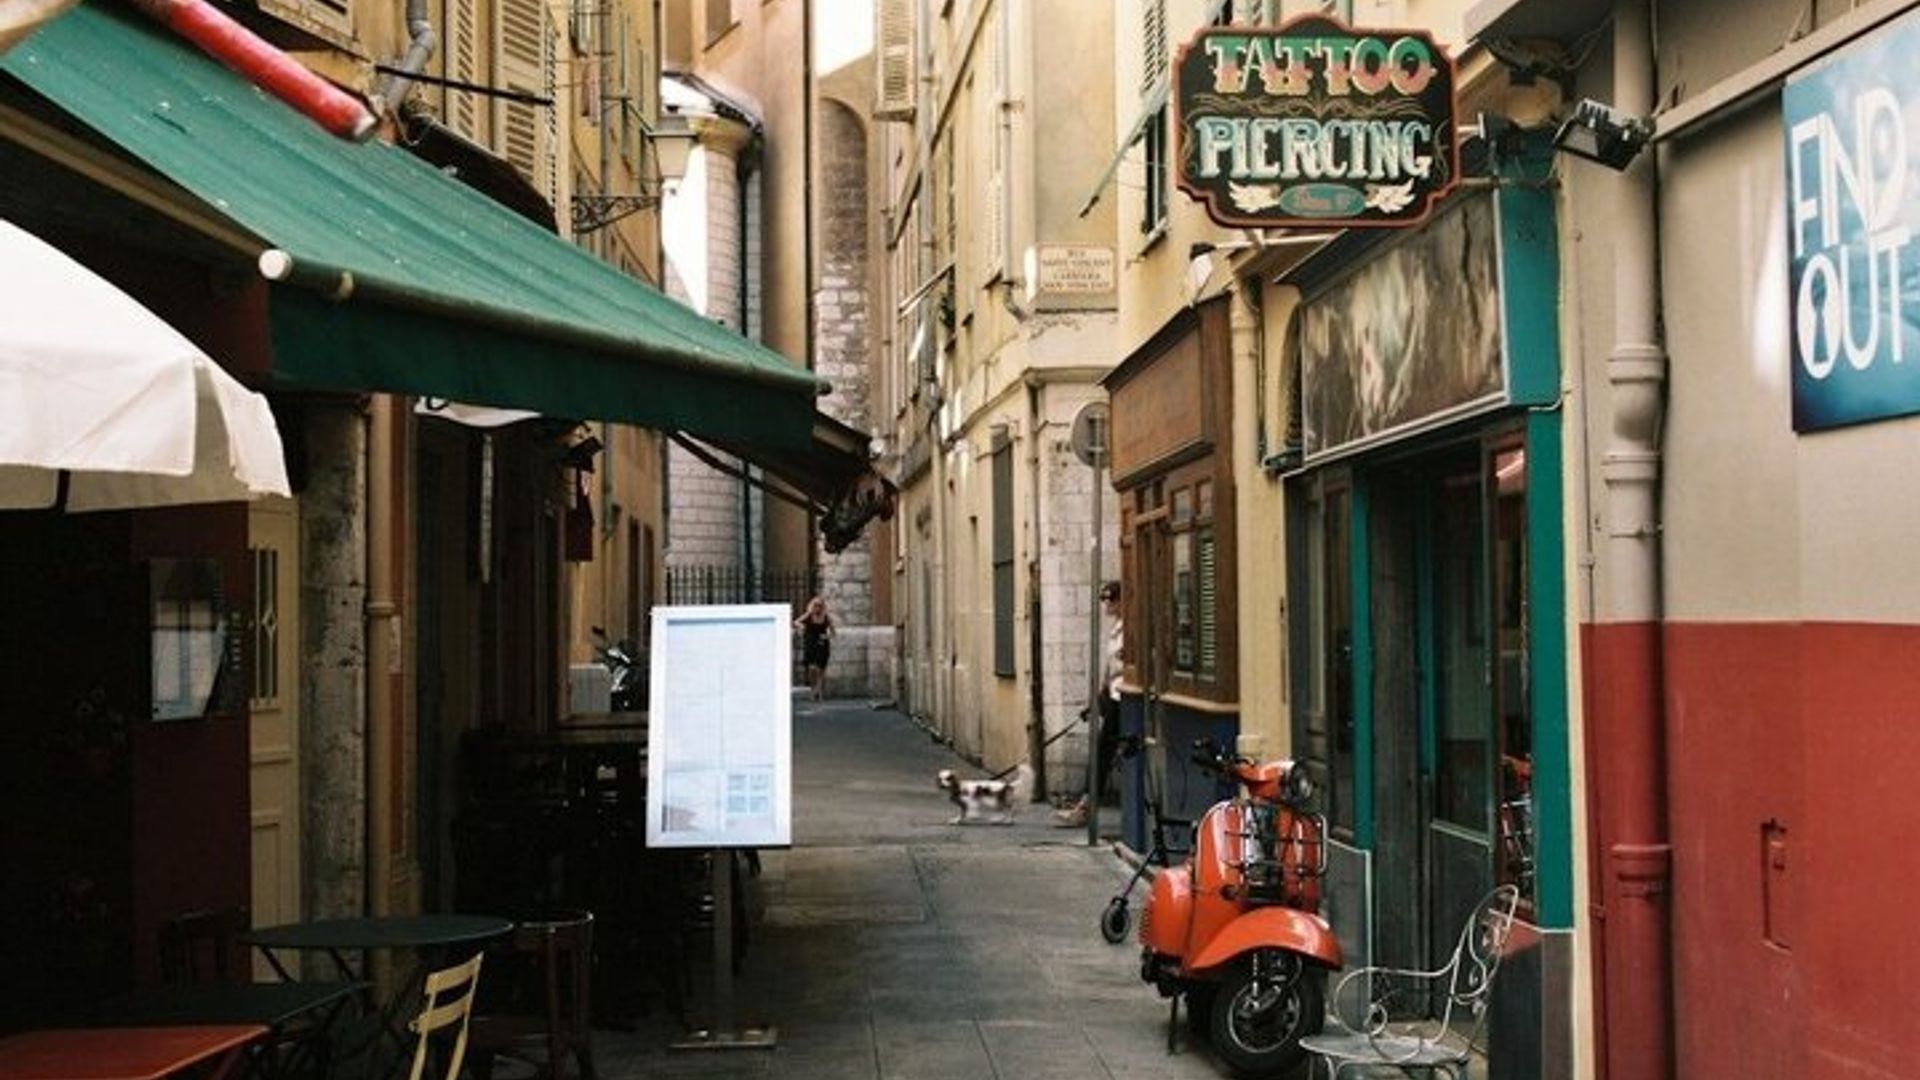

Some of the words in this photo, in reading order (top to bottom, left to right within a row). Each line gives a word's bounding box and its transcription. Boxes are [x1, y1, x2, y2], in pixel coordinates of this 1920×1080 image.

[1206, 36, 1437, 95] TATTOO
[1195, 116, 1432, 178] PIERCING
[1797, 224, 1911, 379] OUT
